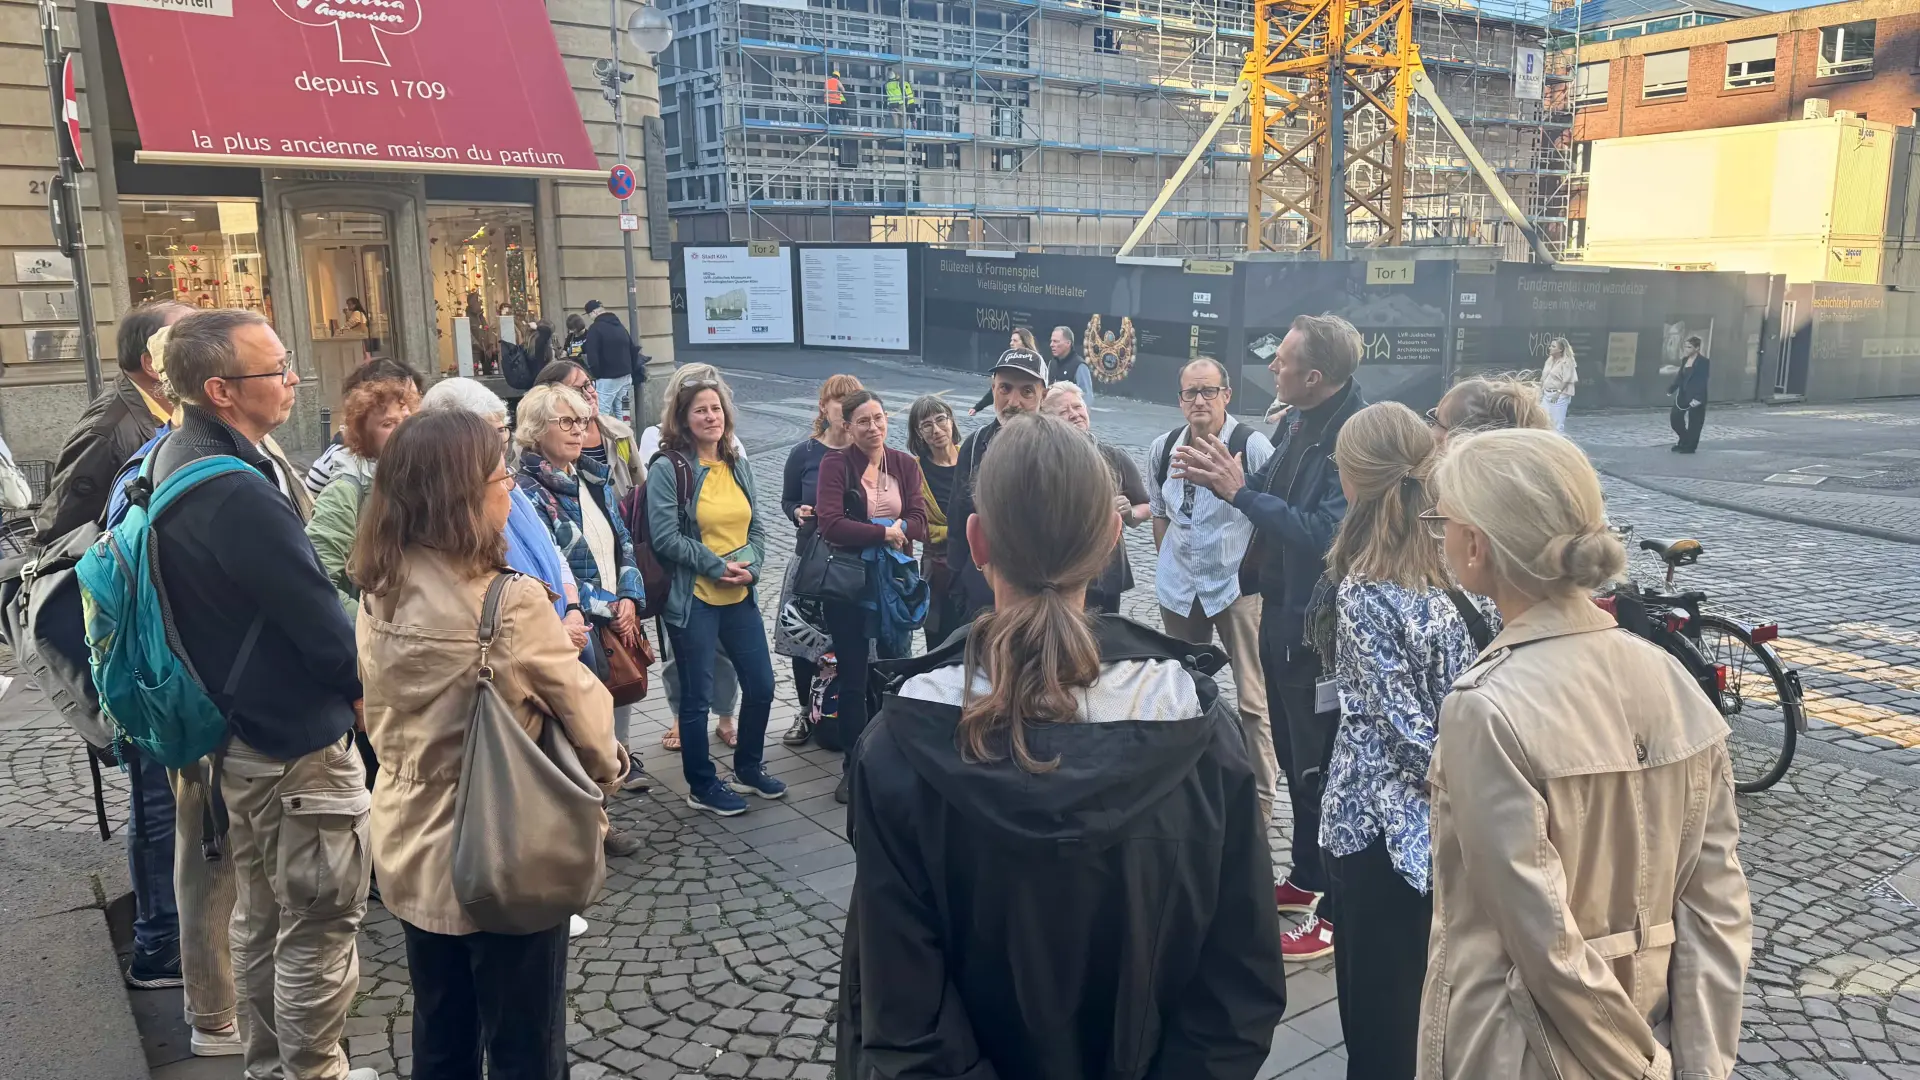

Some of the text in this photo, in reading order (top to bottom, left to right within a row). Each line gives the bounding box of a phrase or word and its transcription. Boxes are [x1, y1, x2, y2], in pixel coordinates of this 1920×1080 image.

[314, 3, 404, 23] Gegenüber
[294, 70, 446, 100] depuis 1709
[191, 129, 565, 166] la plus ancienne maison du parfum
[752, 244, 775, 254] Tor 2
[940, 259, 1040, 281] Blütezeit & Formenspiel
[1375, 267, 1407, 279] Tor 1
[977, 278, 1088, 298] Vielfältiges Kölner Mittelalter
[1517, 275, 1648, 295] Fundamental und wandelbar
[1532, 296, 1597, 311] Bauen im Viertel
[1004, 351, 1033, 364] Gibson
[1396, 346, 1440, 354] Archäologischen
